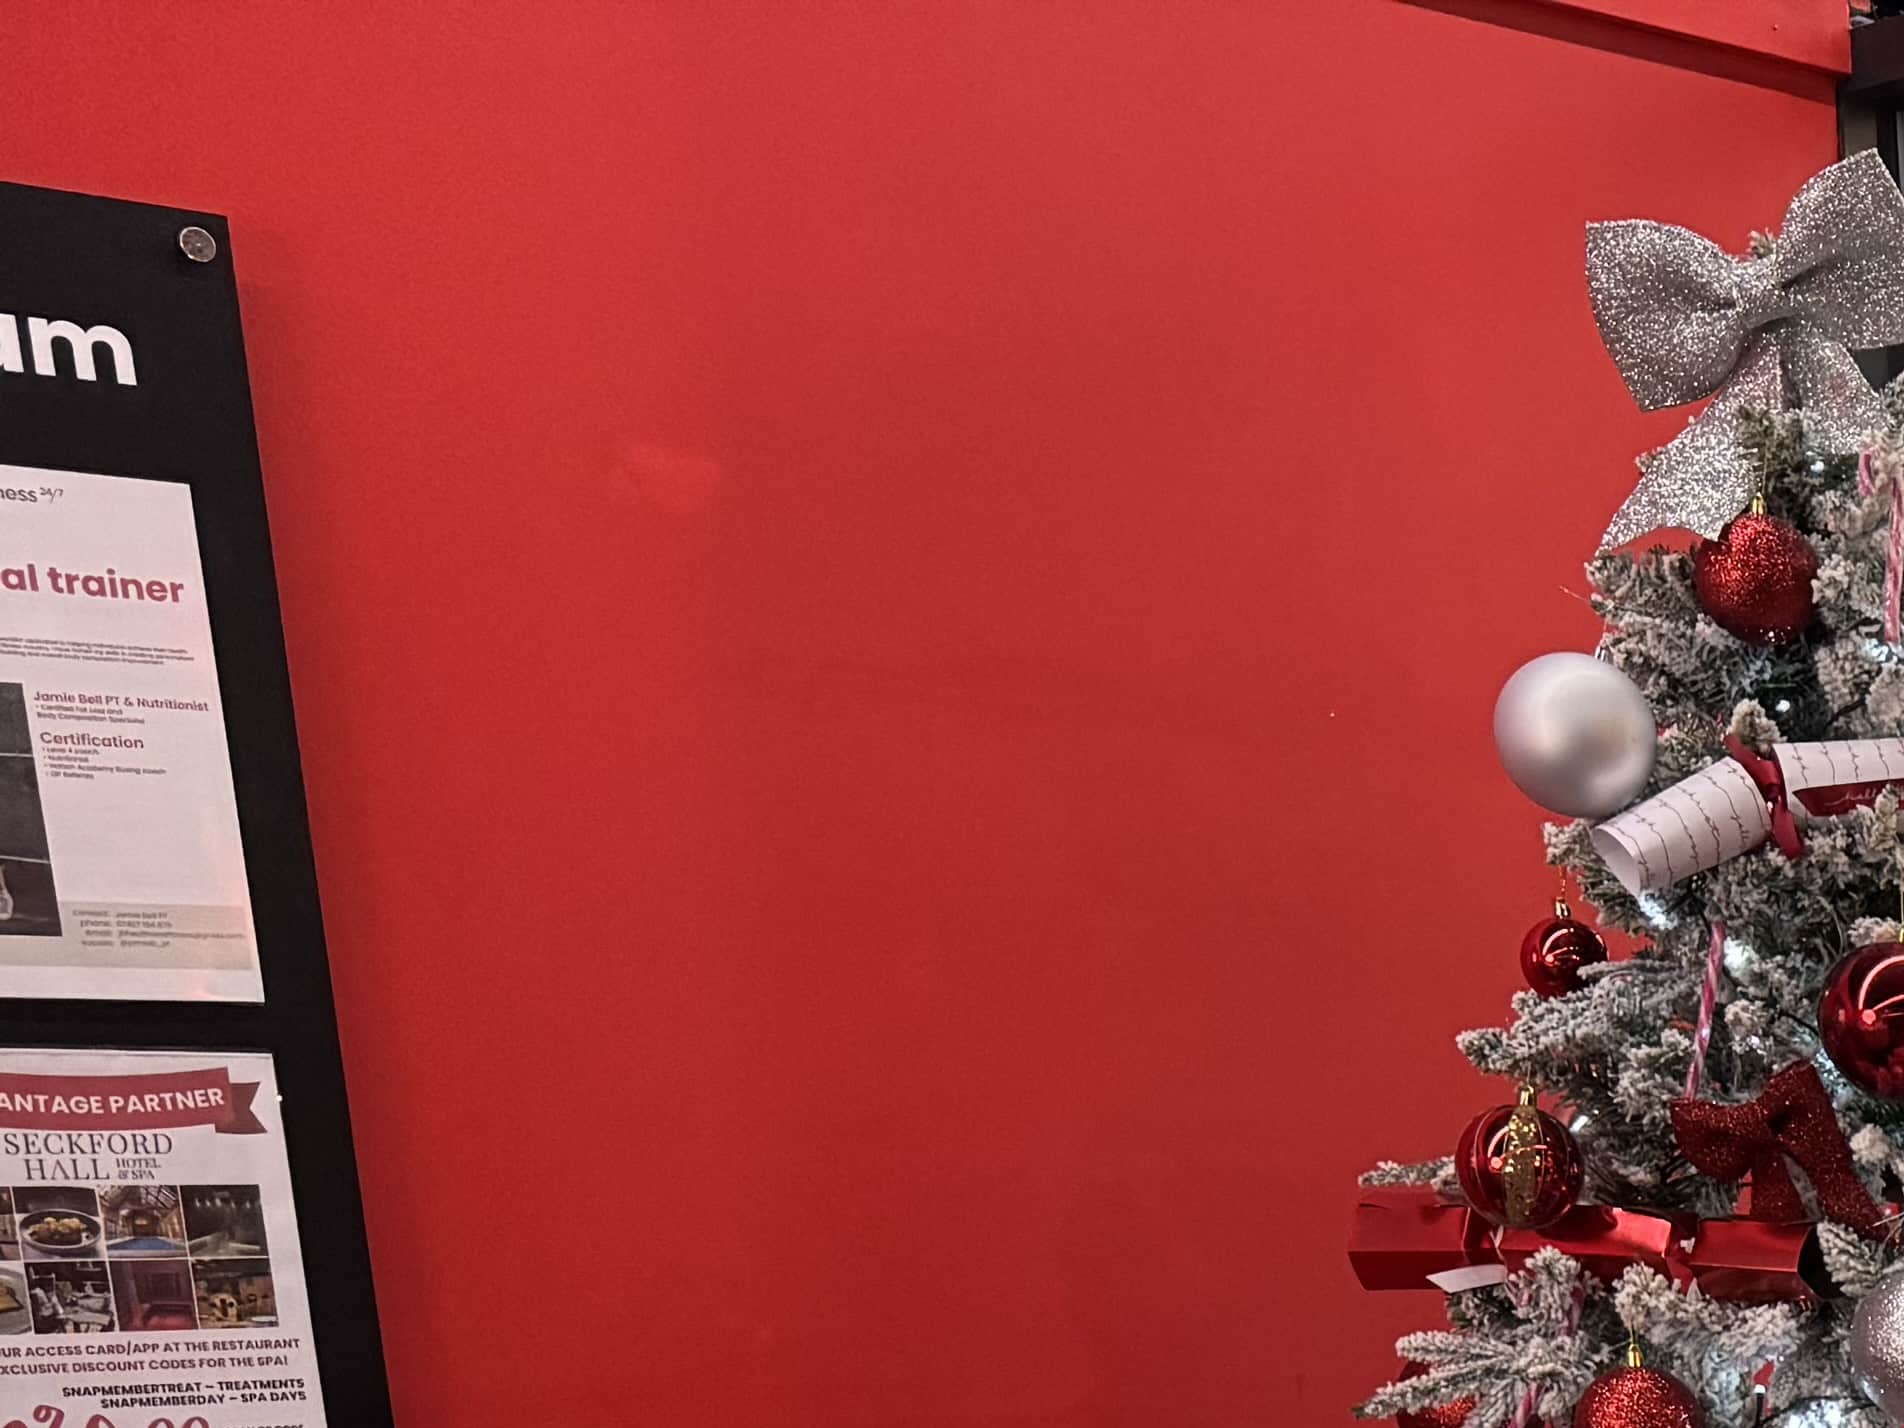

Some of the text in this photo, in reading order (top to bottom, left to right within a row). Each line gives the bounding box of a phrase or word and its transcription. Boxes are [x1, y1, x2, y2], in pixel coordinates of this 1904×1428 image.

[47, 567, 184, 602] trainer
[34, 691, 209, 713] Jamie Bell PT Nutritionist
[40, 731, 144, 750] Certification
[109, 1087, 225, 1114] PARTNER
[3, 1132, 173, 1156] SECKFORD
[25, 1157, 162, 1181] HALL HOTEL
[131, 1170, 156, 1180] SPA
[25, 1337, 301, 1357] ACCESS CARD/APP THE RESTAURANT
[72, 1356, 255, 1374] DISCOUNT CODES FOR THE
[62, 1378, 306, 1398] SNAPMEMBERTREAT TREATMENTS
[100, 1390, 307, 1409] SNAPMEMBERDAY DAYS
